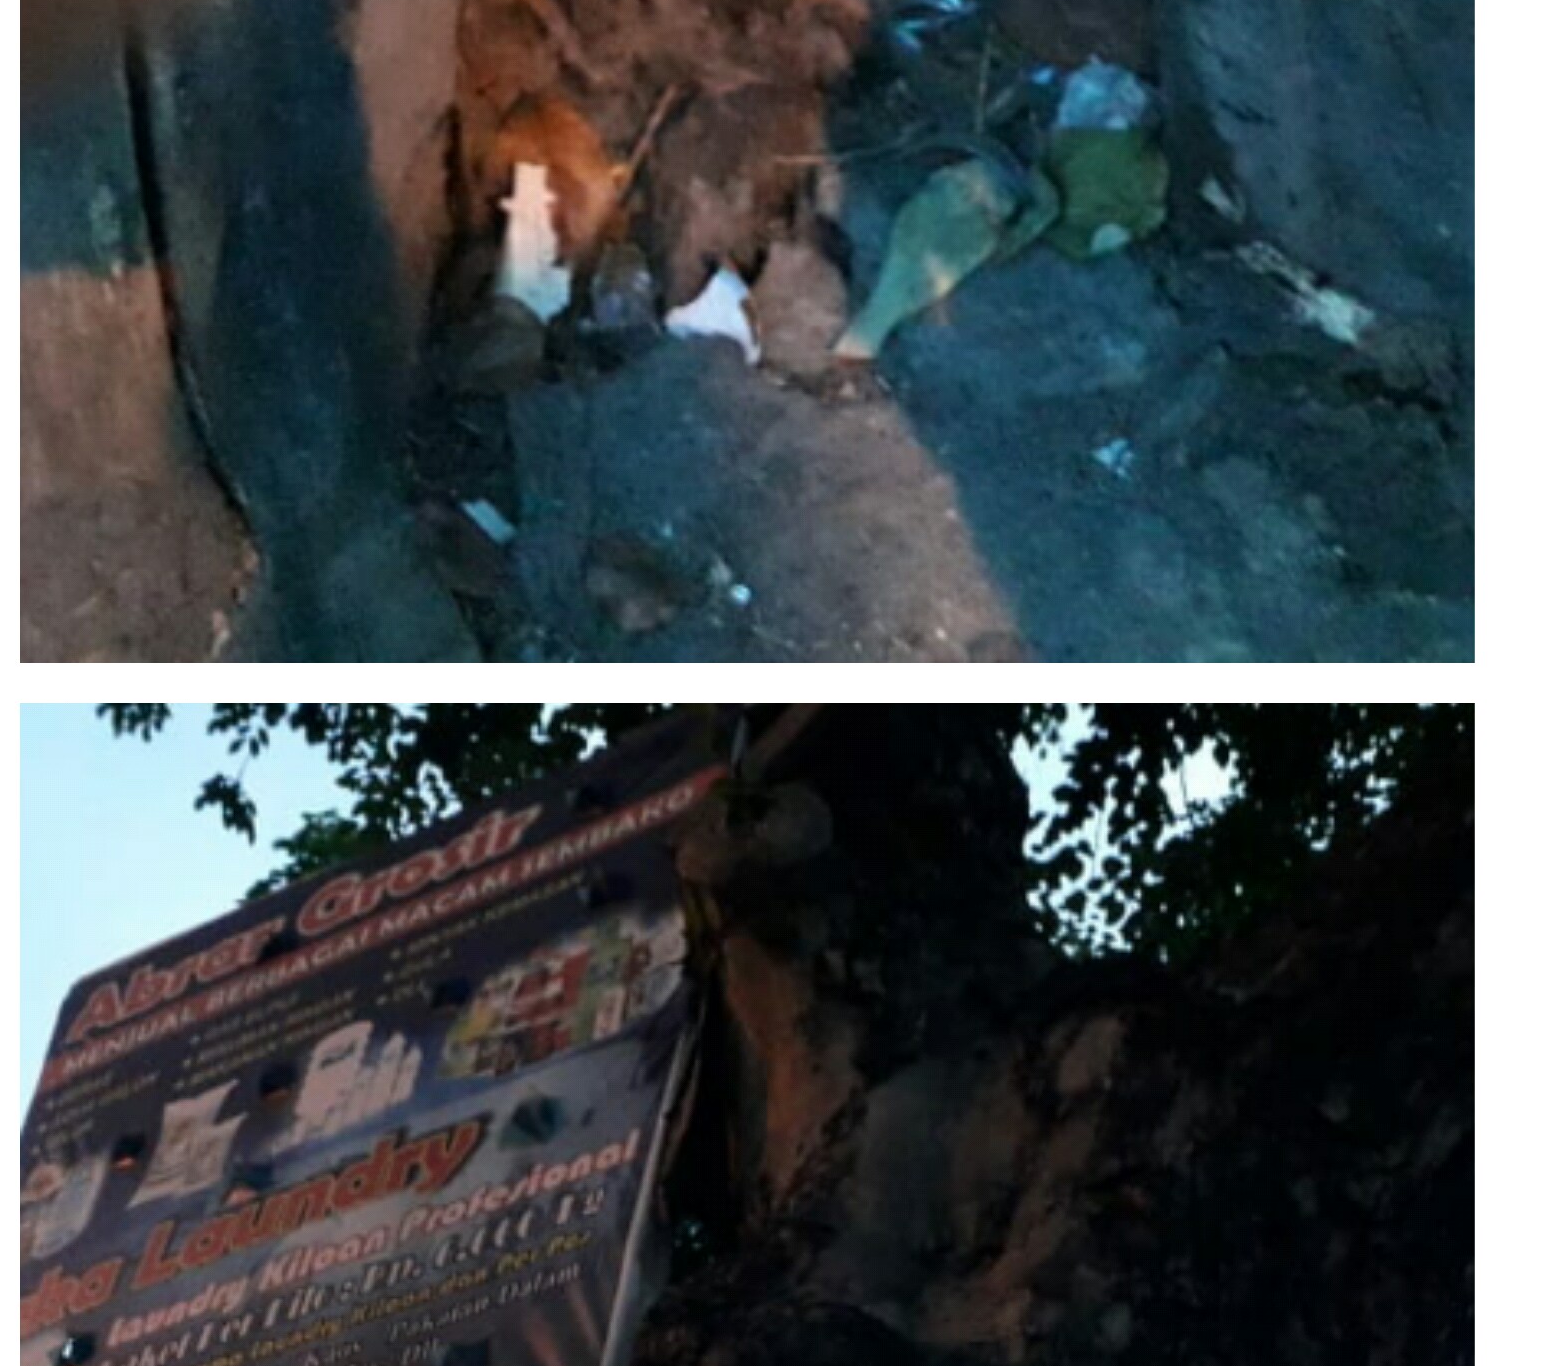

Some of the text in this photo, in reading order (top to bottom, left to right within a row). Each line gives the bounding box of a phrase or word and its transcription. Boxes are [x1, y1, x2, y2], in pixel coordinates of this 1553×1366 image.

[62, 787, 693, 1076] MENJUAL BERBAGAI MACAM SEMBAKO
[297, 803, 544, 935] Grosir
[107, 1127, 641, 1347] laundry Kiloan Profesional
[131, 1117, 483, 1290] Laundry
